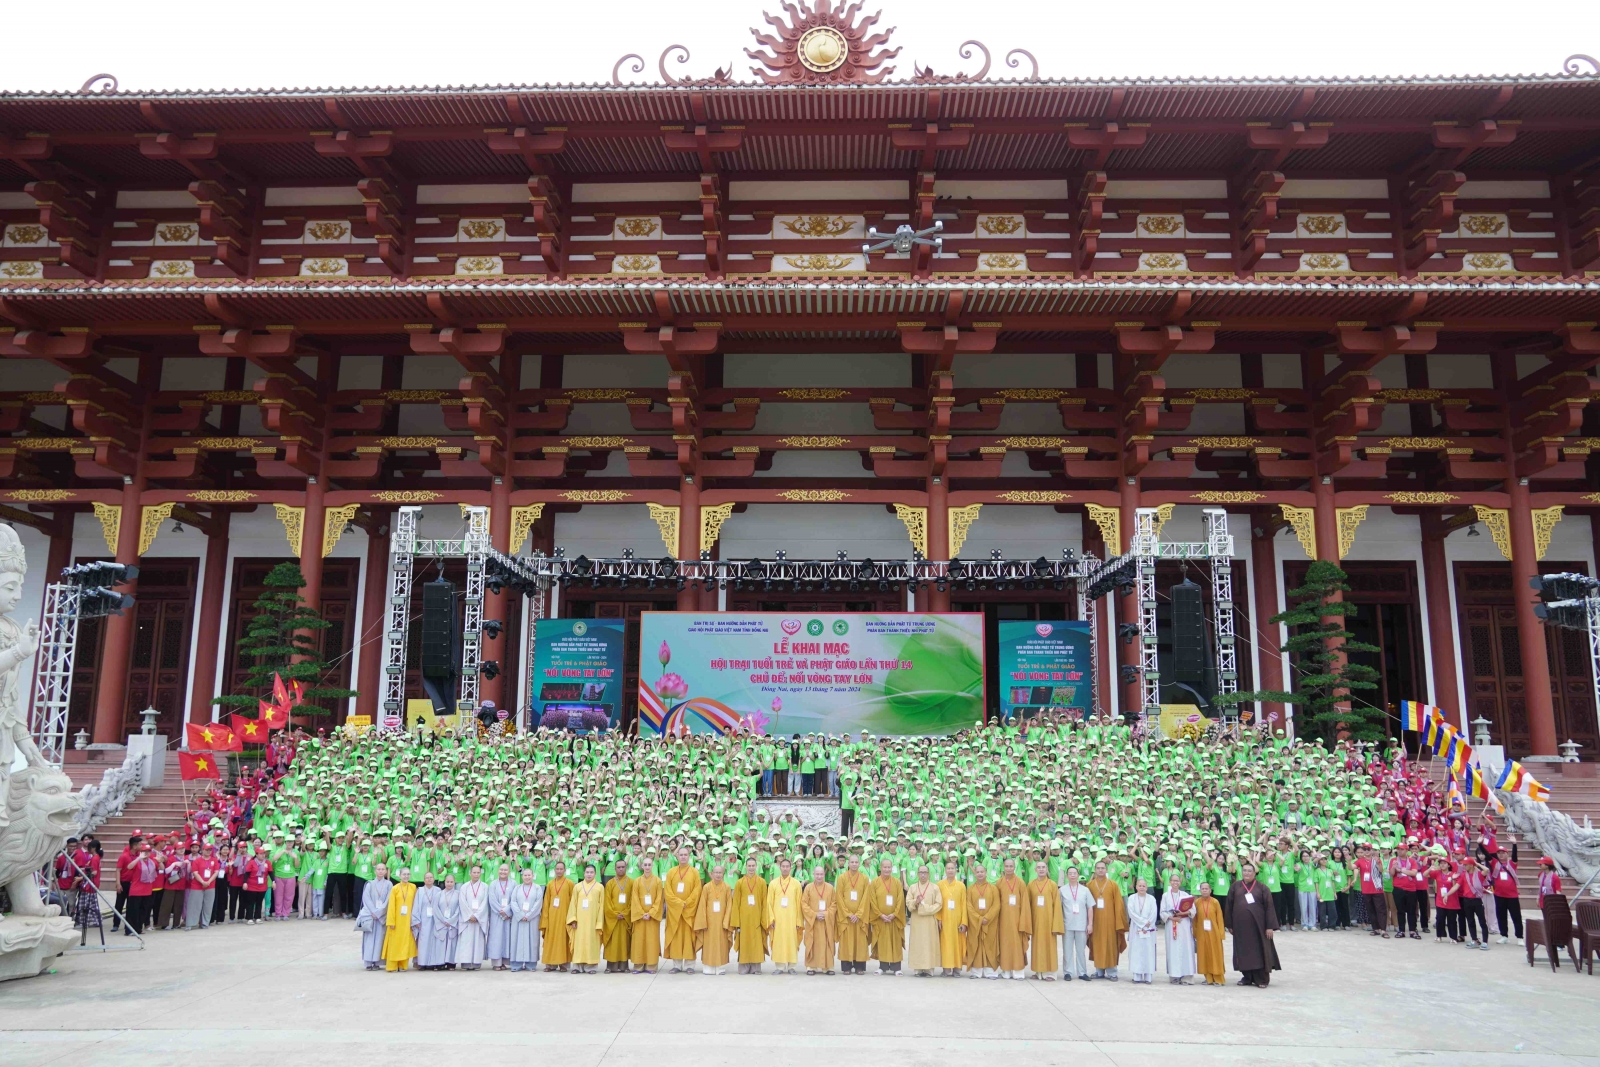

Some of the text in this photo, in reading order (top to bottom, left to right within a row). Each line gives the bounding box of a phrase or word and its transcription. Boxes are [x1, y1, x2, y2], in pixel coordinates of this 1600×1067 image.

[773, 637, 850, 658] LỄ KHAI MẠC
[710, 656, 913, 672] HỘI TRẠI TUỔI TRẺ VÀ PHẬT GIÁO LẦN THỨ 14
[750, 671, 873, 684] CHỦ ĐỀ: NỐI VÒNG TAY LỚN
